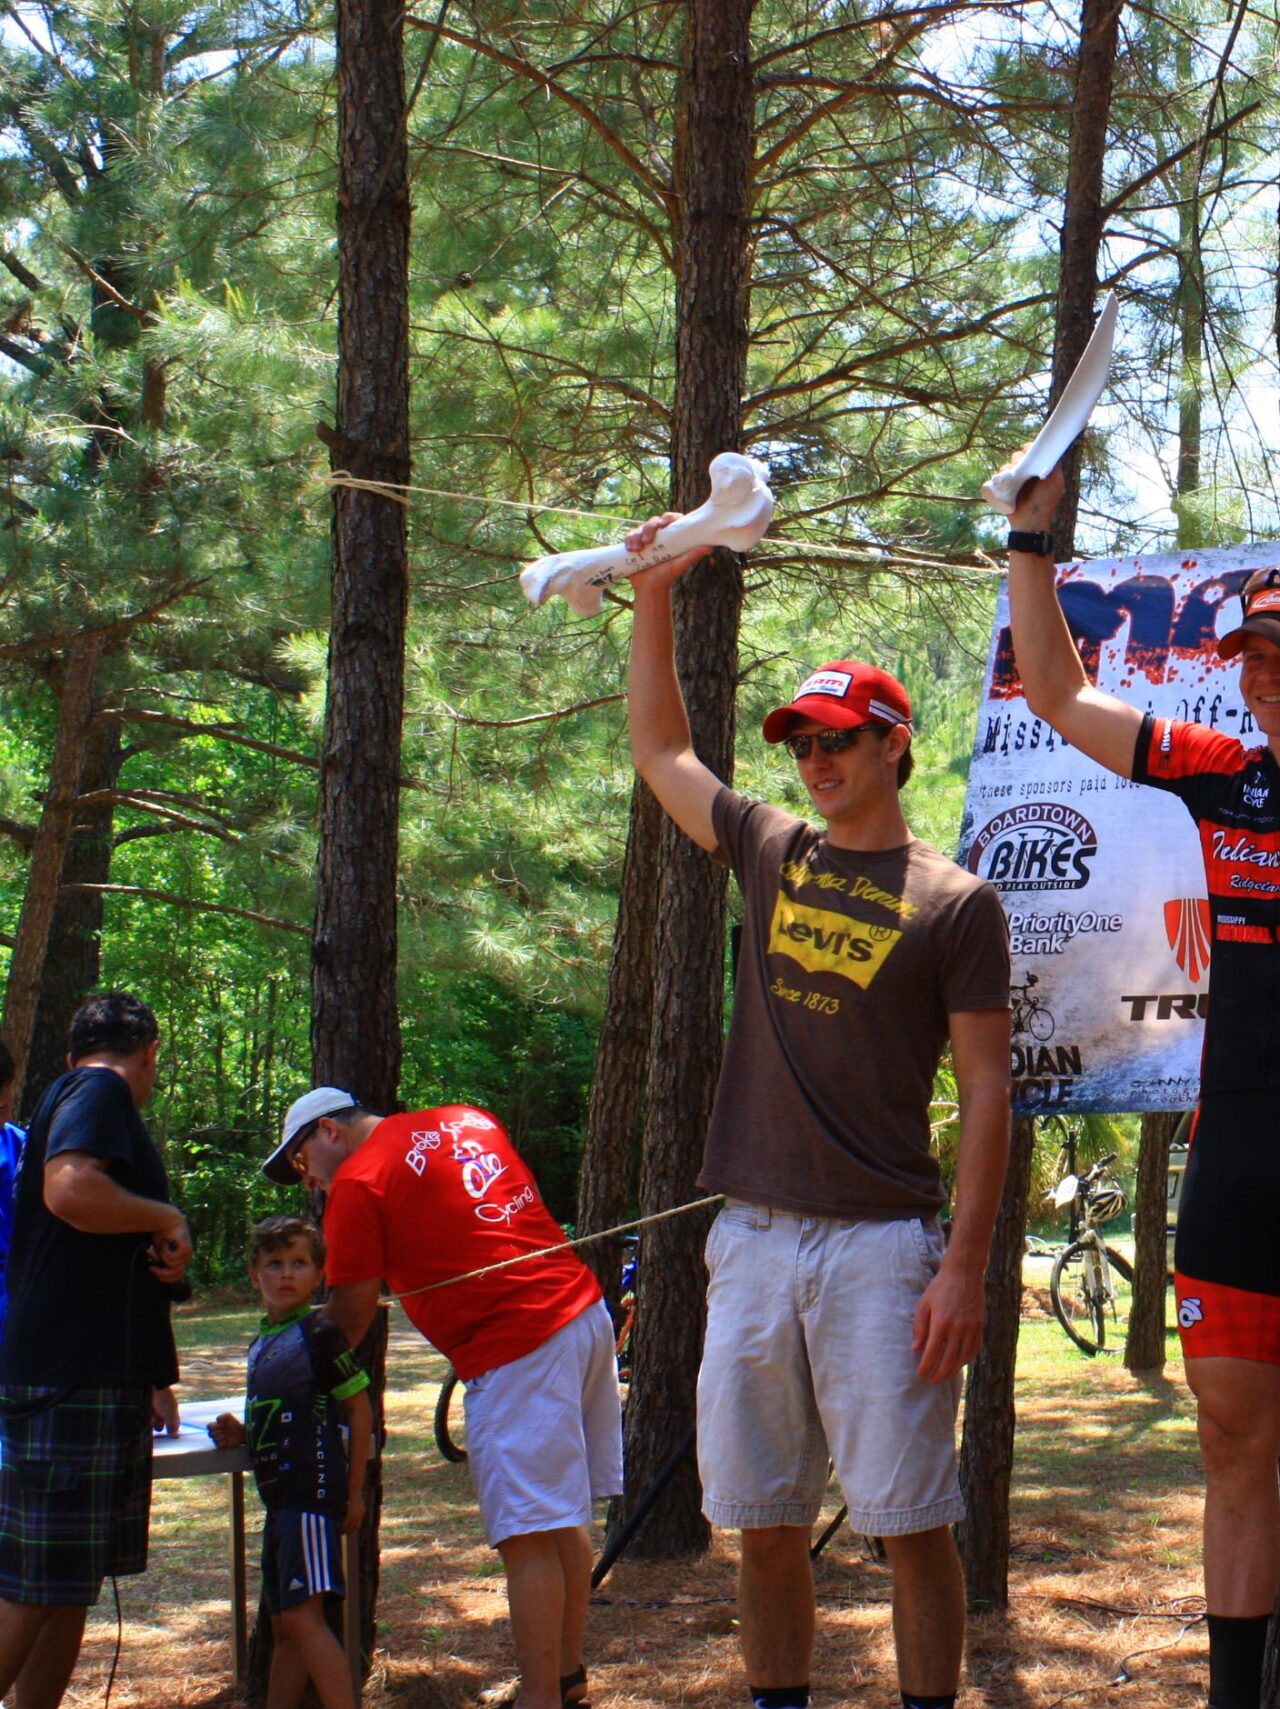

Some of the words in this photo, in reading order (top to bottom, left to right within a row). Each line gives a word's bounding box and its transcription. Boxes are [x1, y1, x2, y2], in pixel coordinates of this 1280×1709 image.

[1019, 779, 1073, 800] sponsors
[1079, 775, 1107, 796] paid
[978, 804, 1092, 848] BOARDTOWN
[986, 837, 1098, 888] BIKES
[1005, 881, 1029, 890] PLAY
[1031, 880, 1077, 890] OUTSIDE
[1009, 910, 1124, 938] PriorityOne
[1010, 934, 1066, 955] Bank
[802, 991, 840, 1015] 1873
[1010, 1045, 1083, 1078] DIAN
[474, 1185, 535, 1228] Cycling
